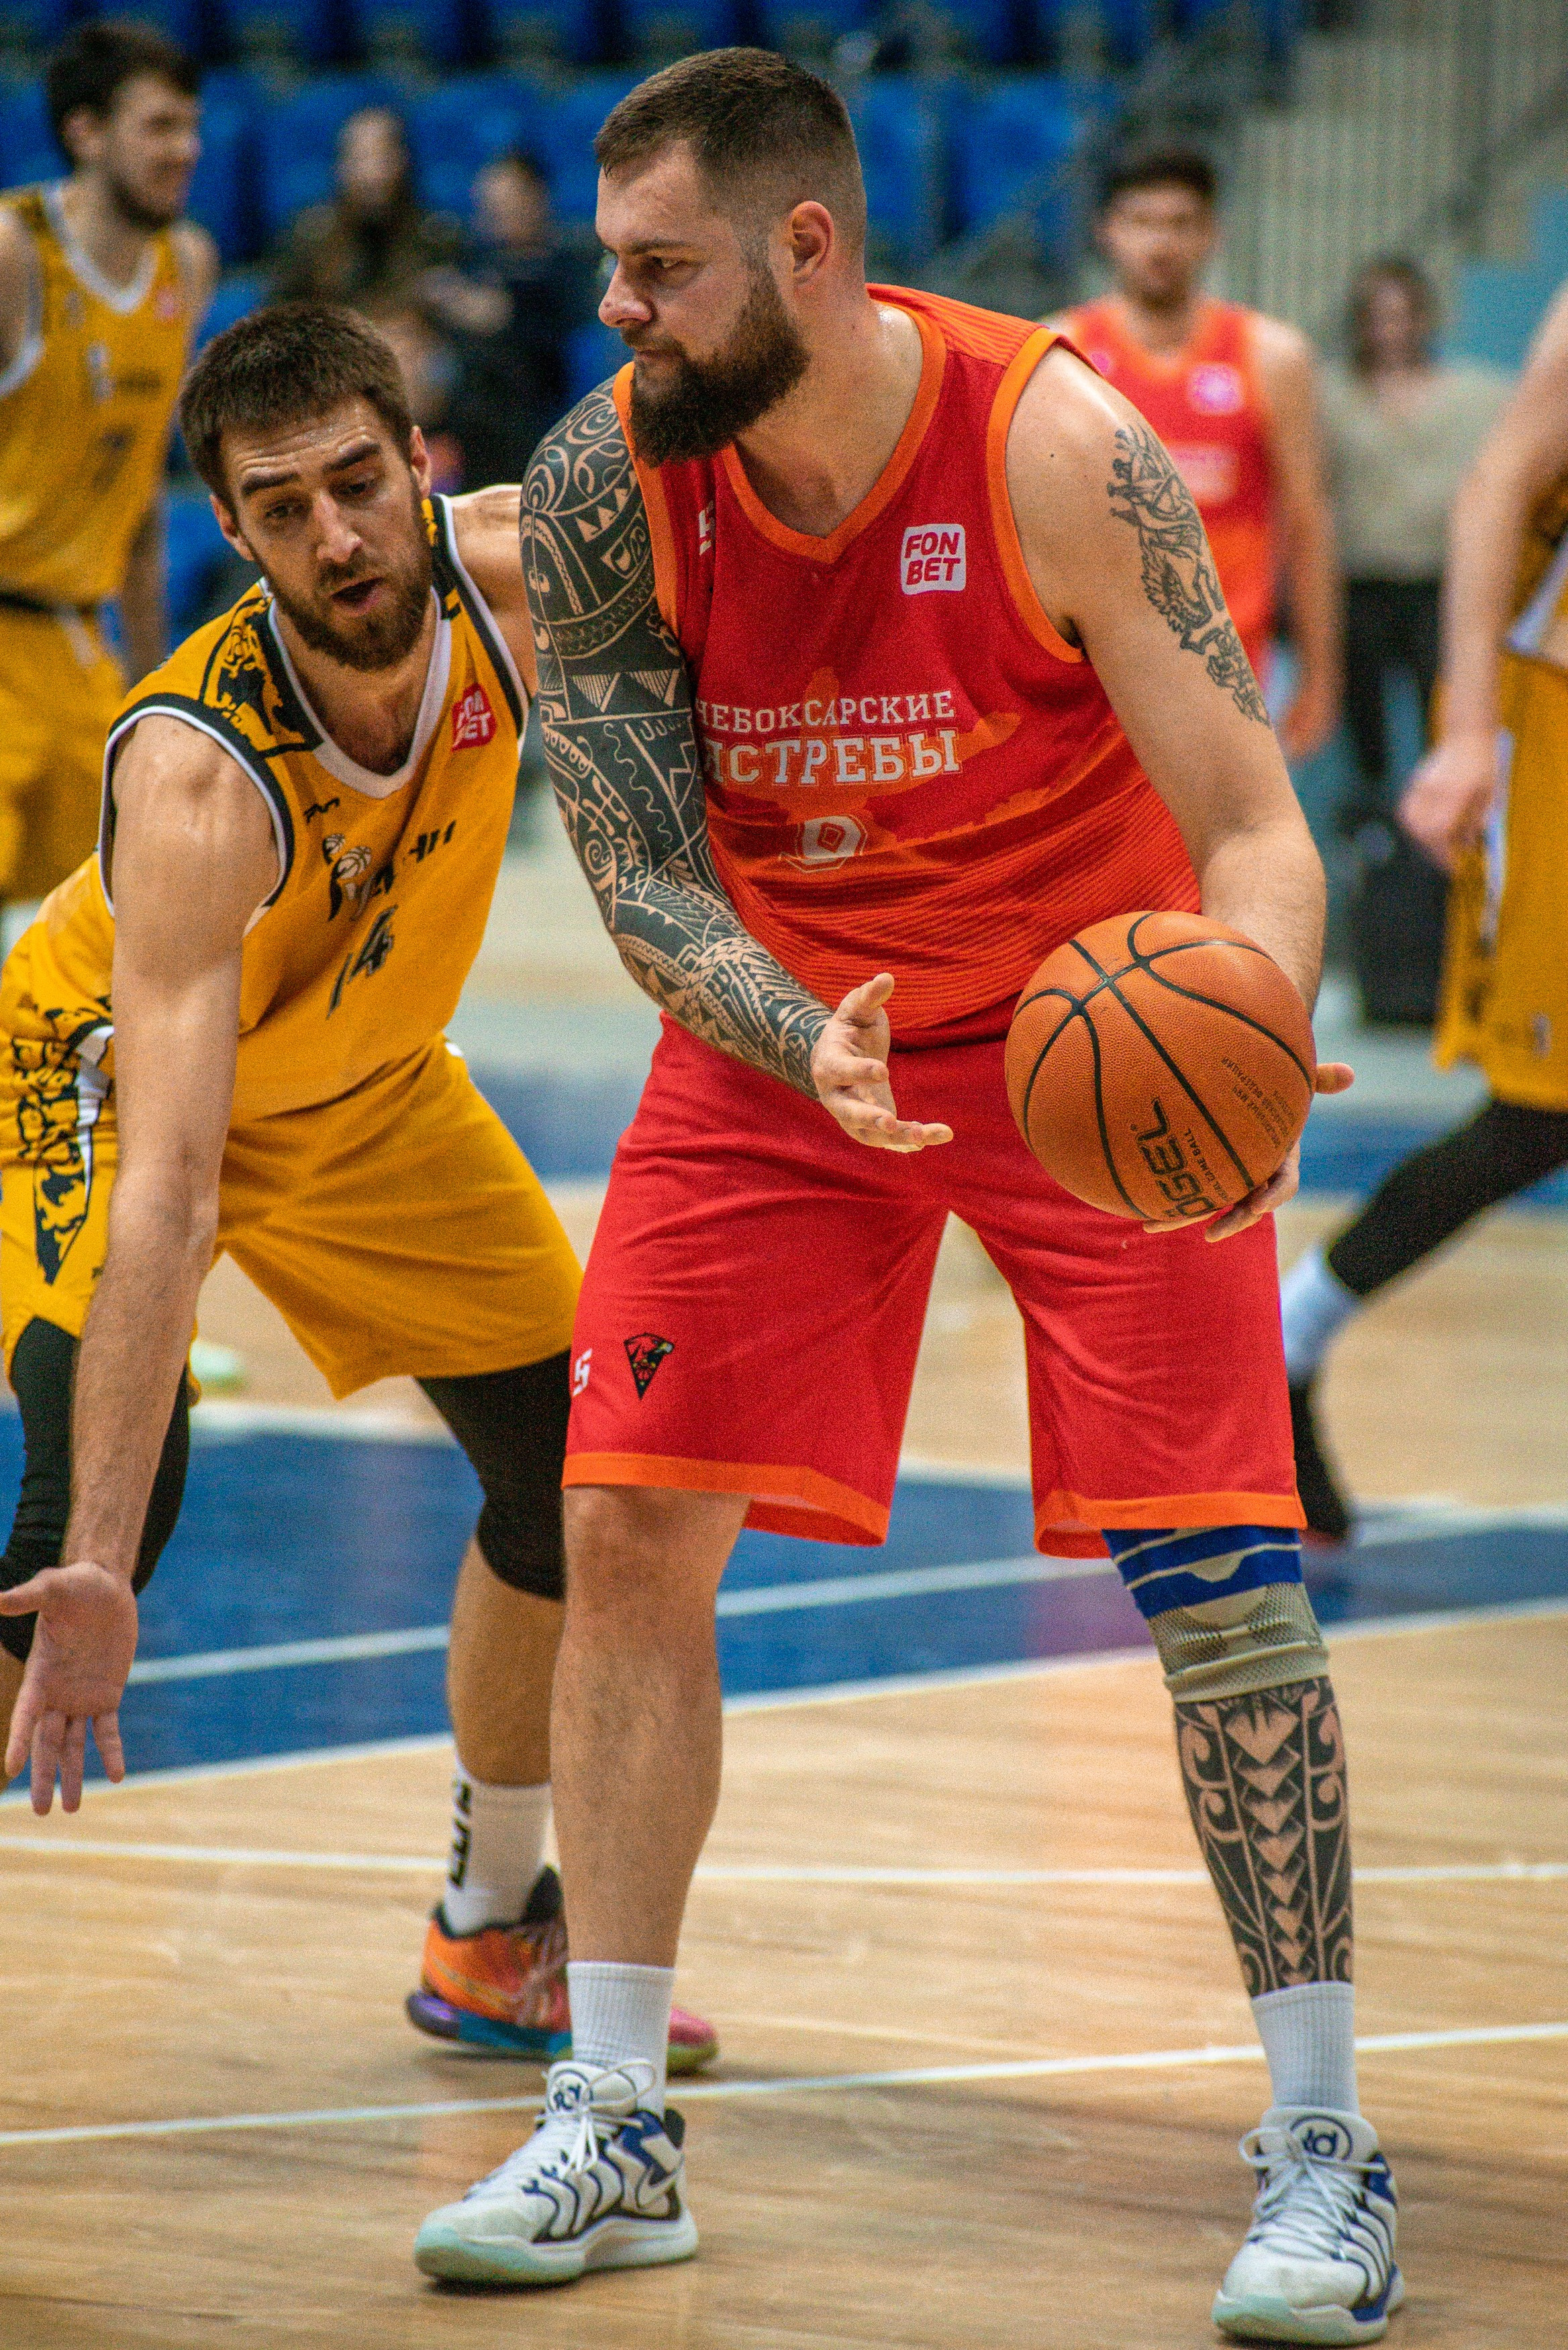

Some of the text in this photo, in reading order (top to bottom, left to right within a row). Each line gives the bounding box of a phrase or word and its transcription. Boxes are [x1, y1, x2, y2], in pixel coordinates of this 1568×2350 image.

[904, 531, 961, 559] FON
[905, 557, 962, 586] BET
[1183, 1128, 1202, 1156] BALL
